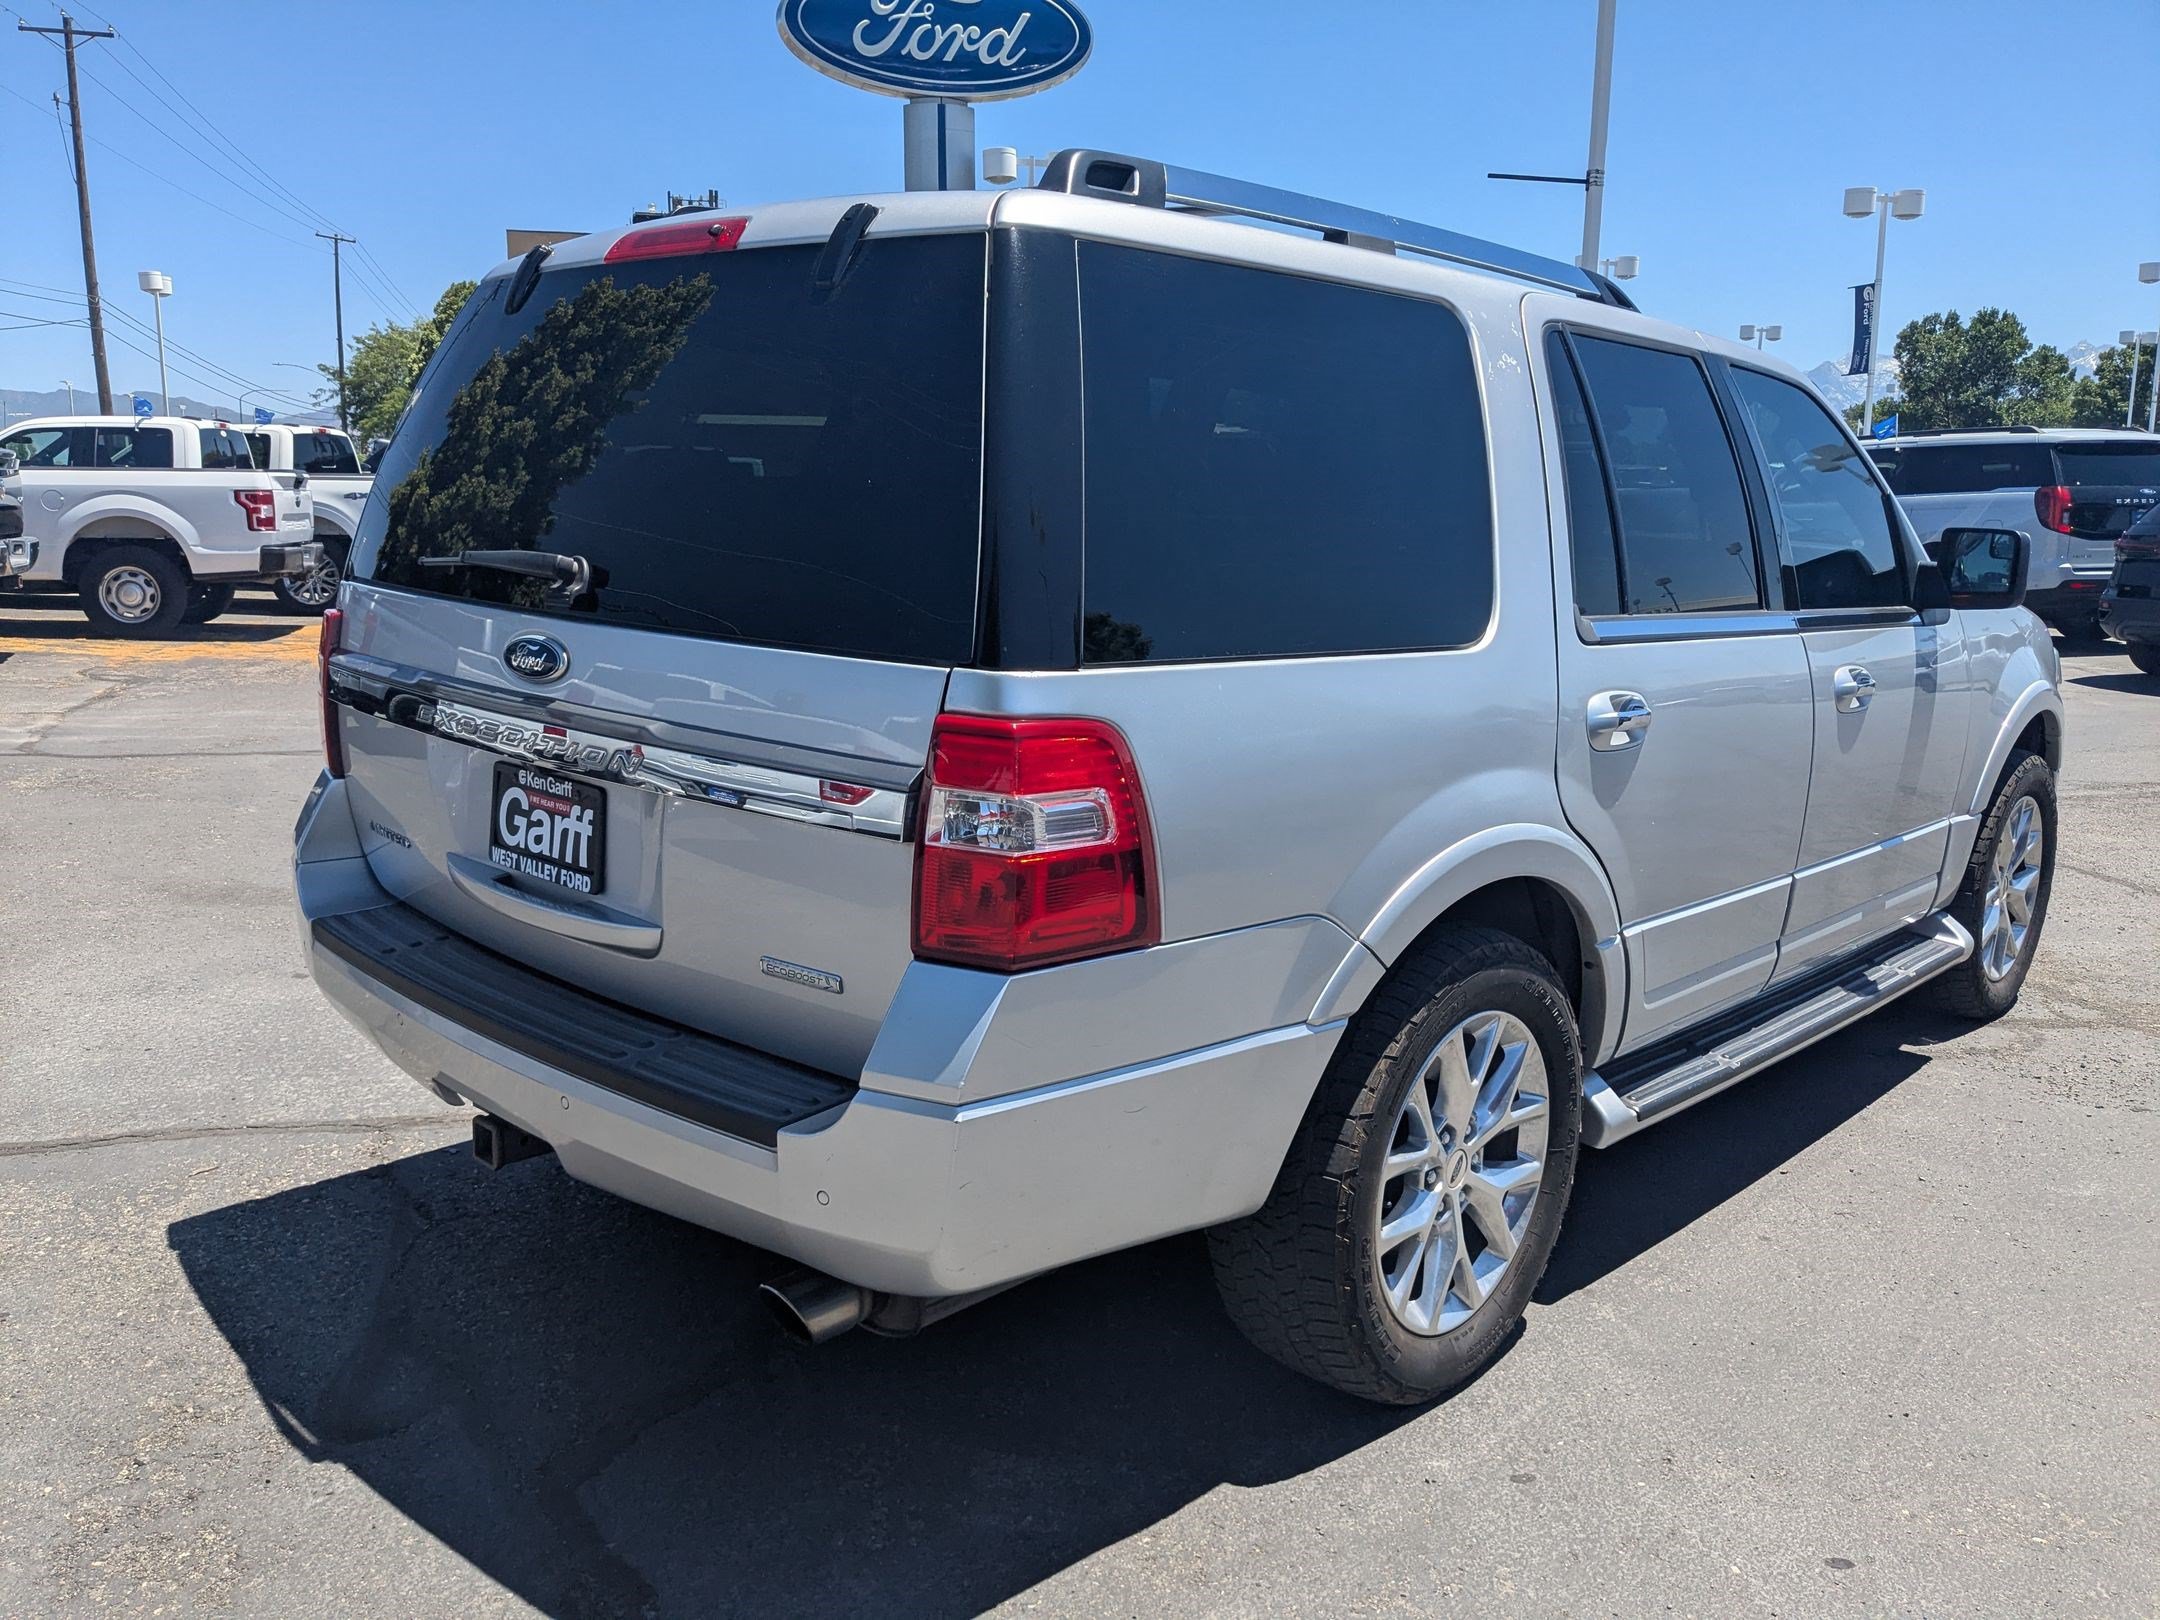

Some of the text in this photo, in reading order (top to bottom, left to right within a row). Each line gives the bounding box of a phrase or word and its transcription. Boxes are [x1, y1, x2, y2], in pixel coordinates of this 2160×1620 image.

[853, 0, 1031, 66] Ford
[511, 642, 547, 671] Ford
[416, 704, 645, 775] EXPEDITION
[527, 770, 572, 798] Ken Garff
[540, 798, 555, 809] HEAR
[499, 786, 594, 868] Garff
[491, 846, 592, 893] WEST VALLEY FORD
[766, 963, 823, 985] ECOBOOST
